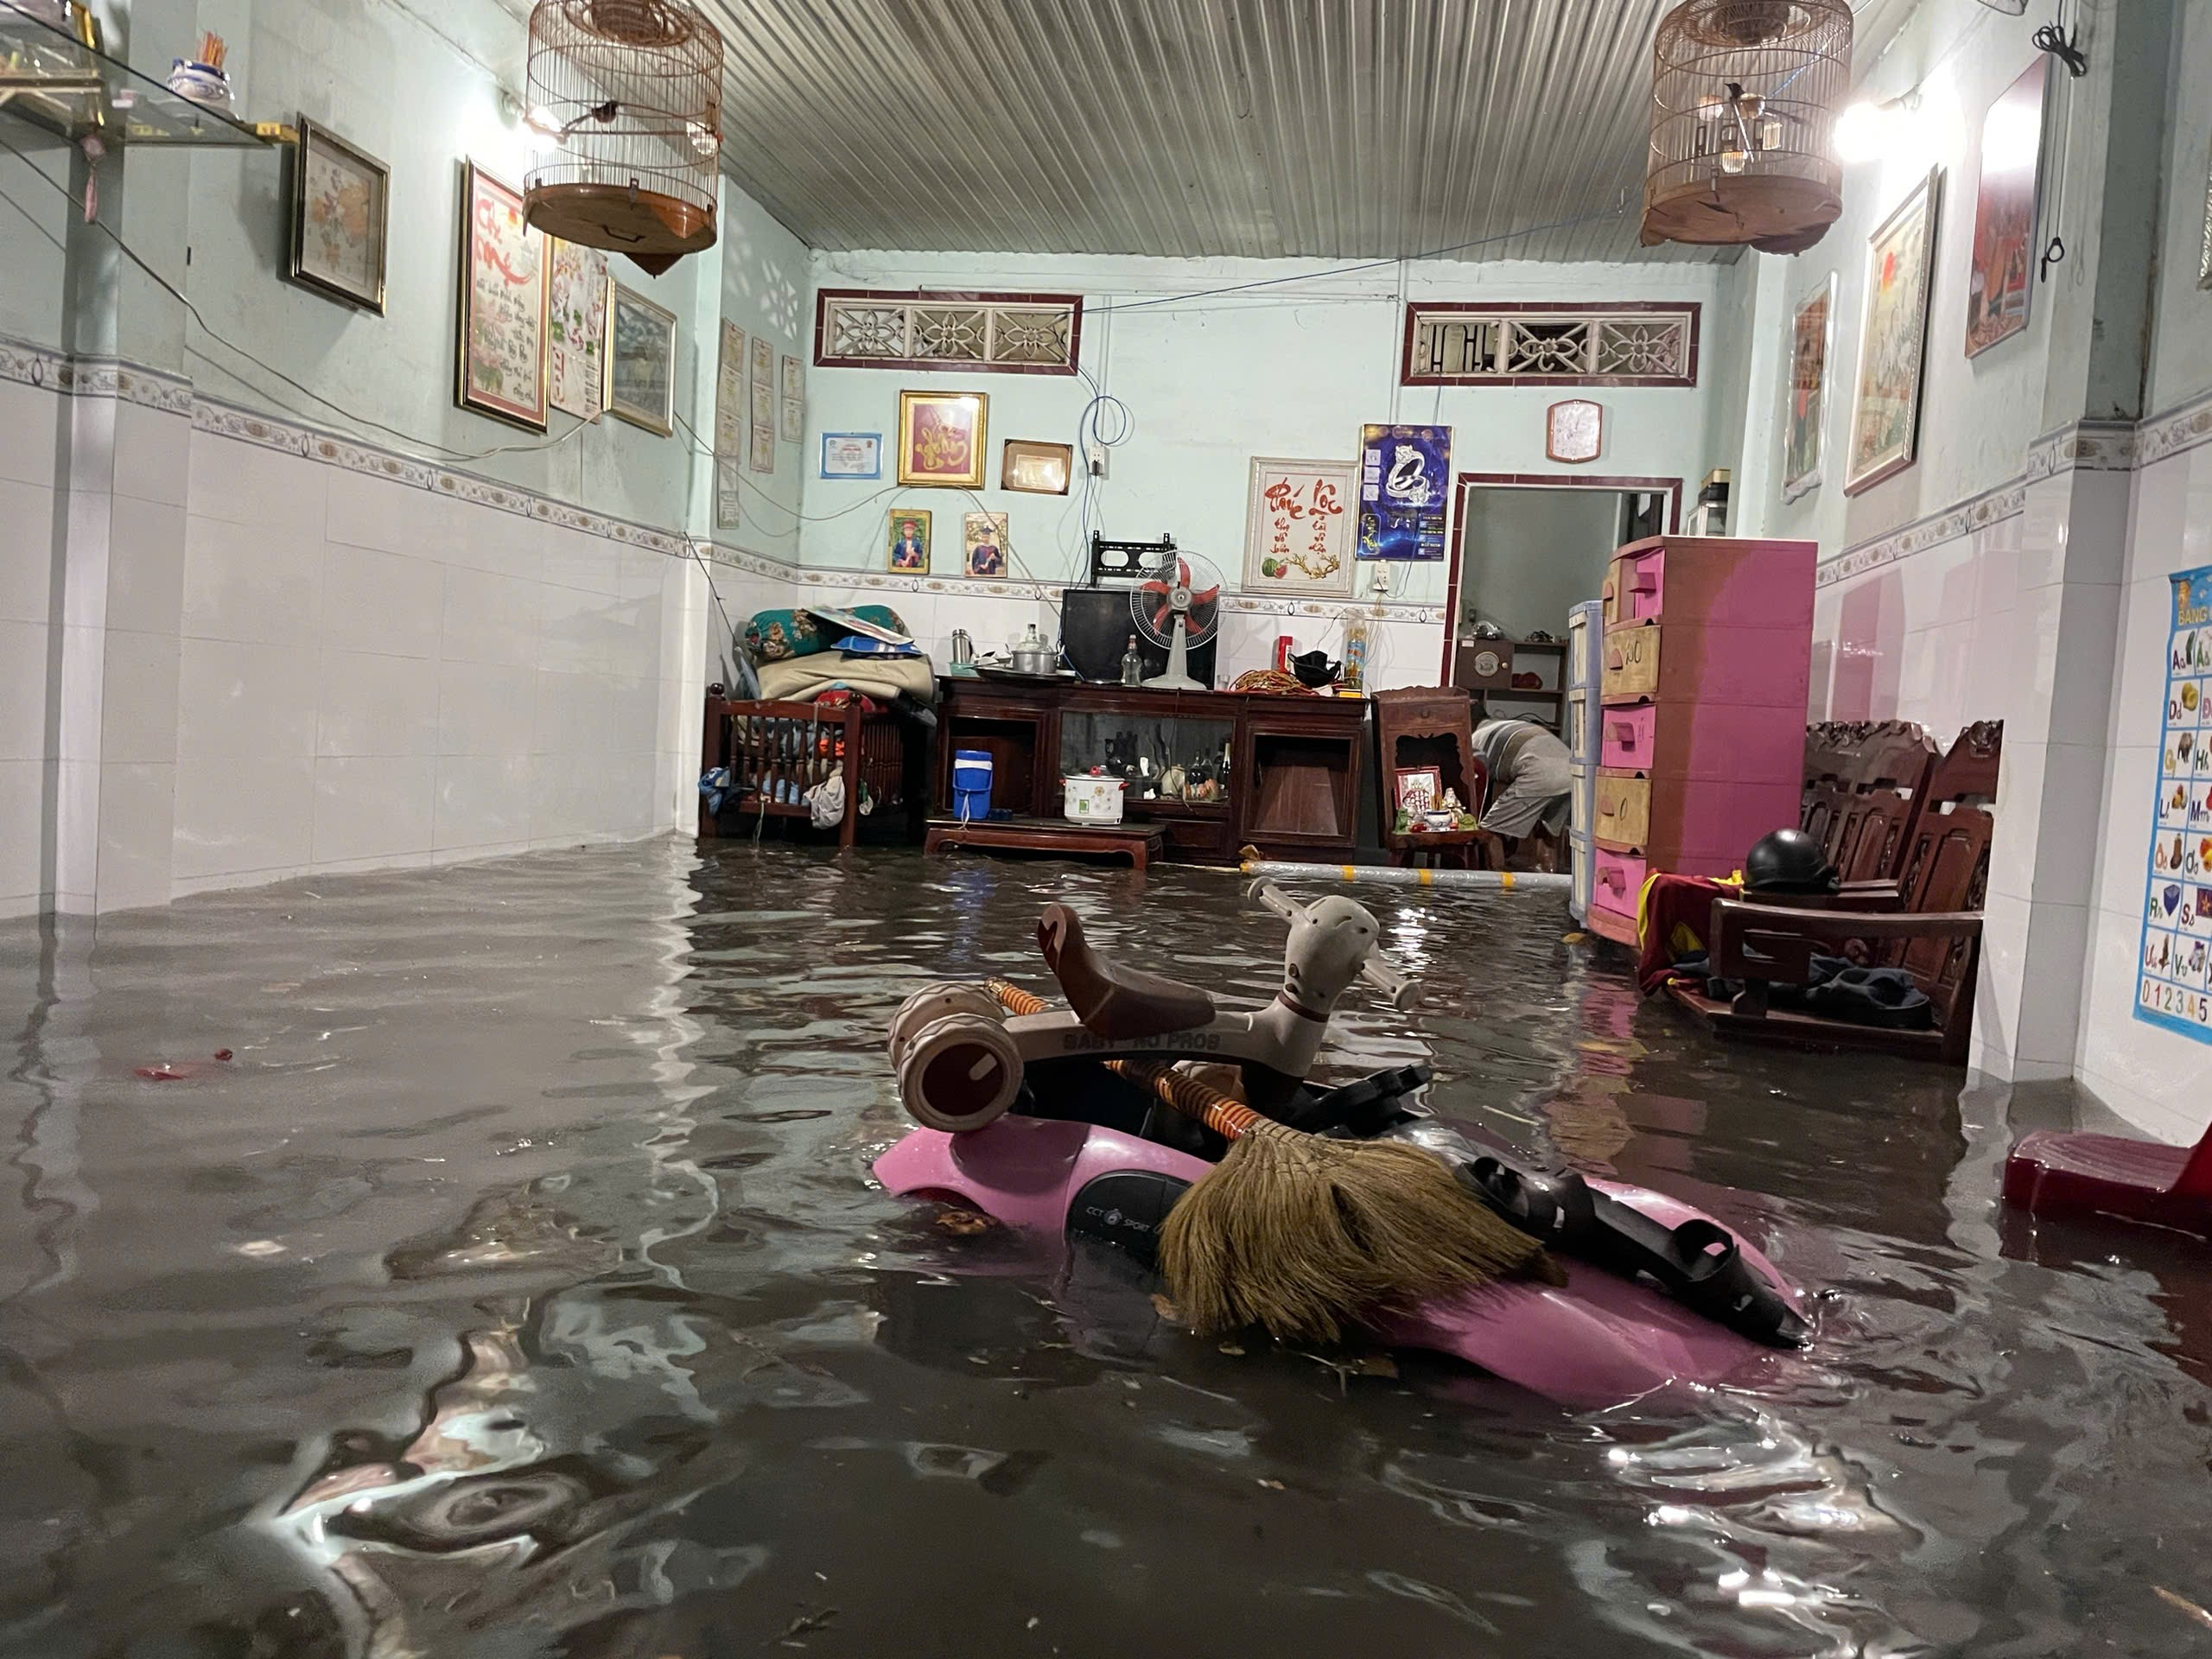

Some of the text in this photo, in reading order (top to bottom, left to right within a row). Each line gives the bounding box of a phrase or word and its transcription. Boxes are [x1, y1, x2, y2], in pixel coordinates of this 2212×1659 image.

[2143, 979, 2208, 1022] 0 1 2 3 4 5
